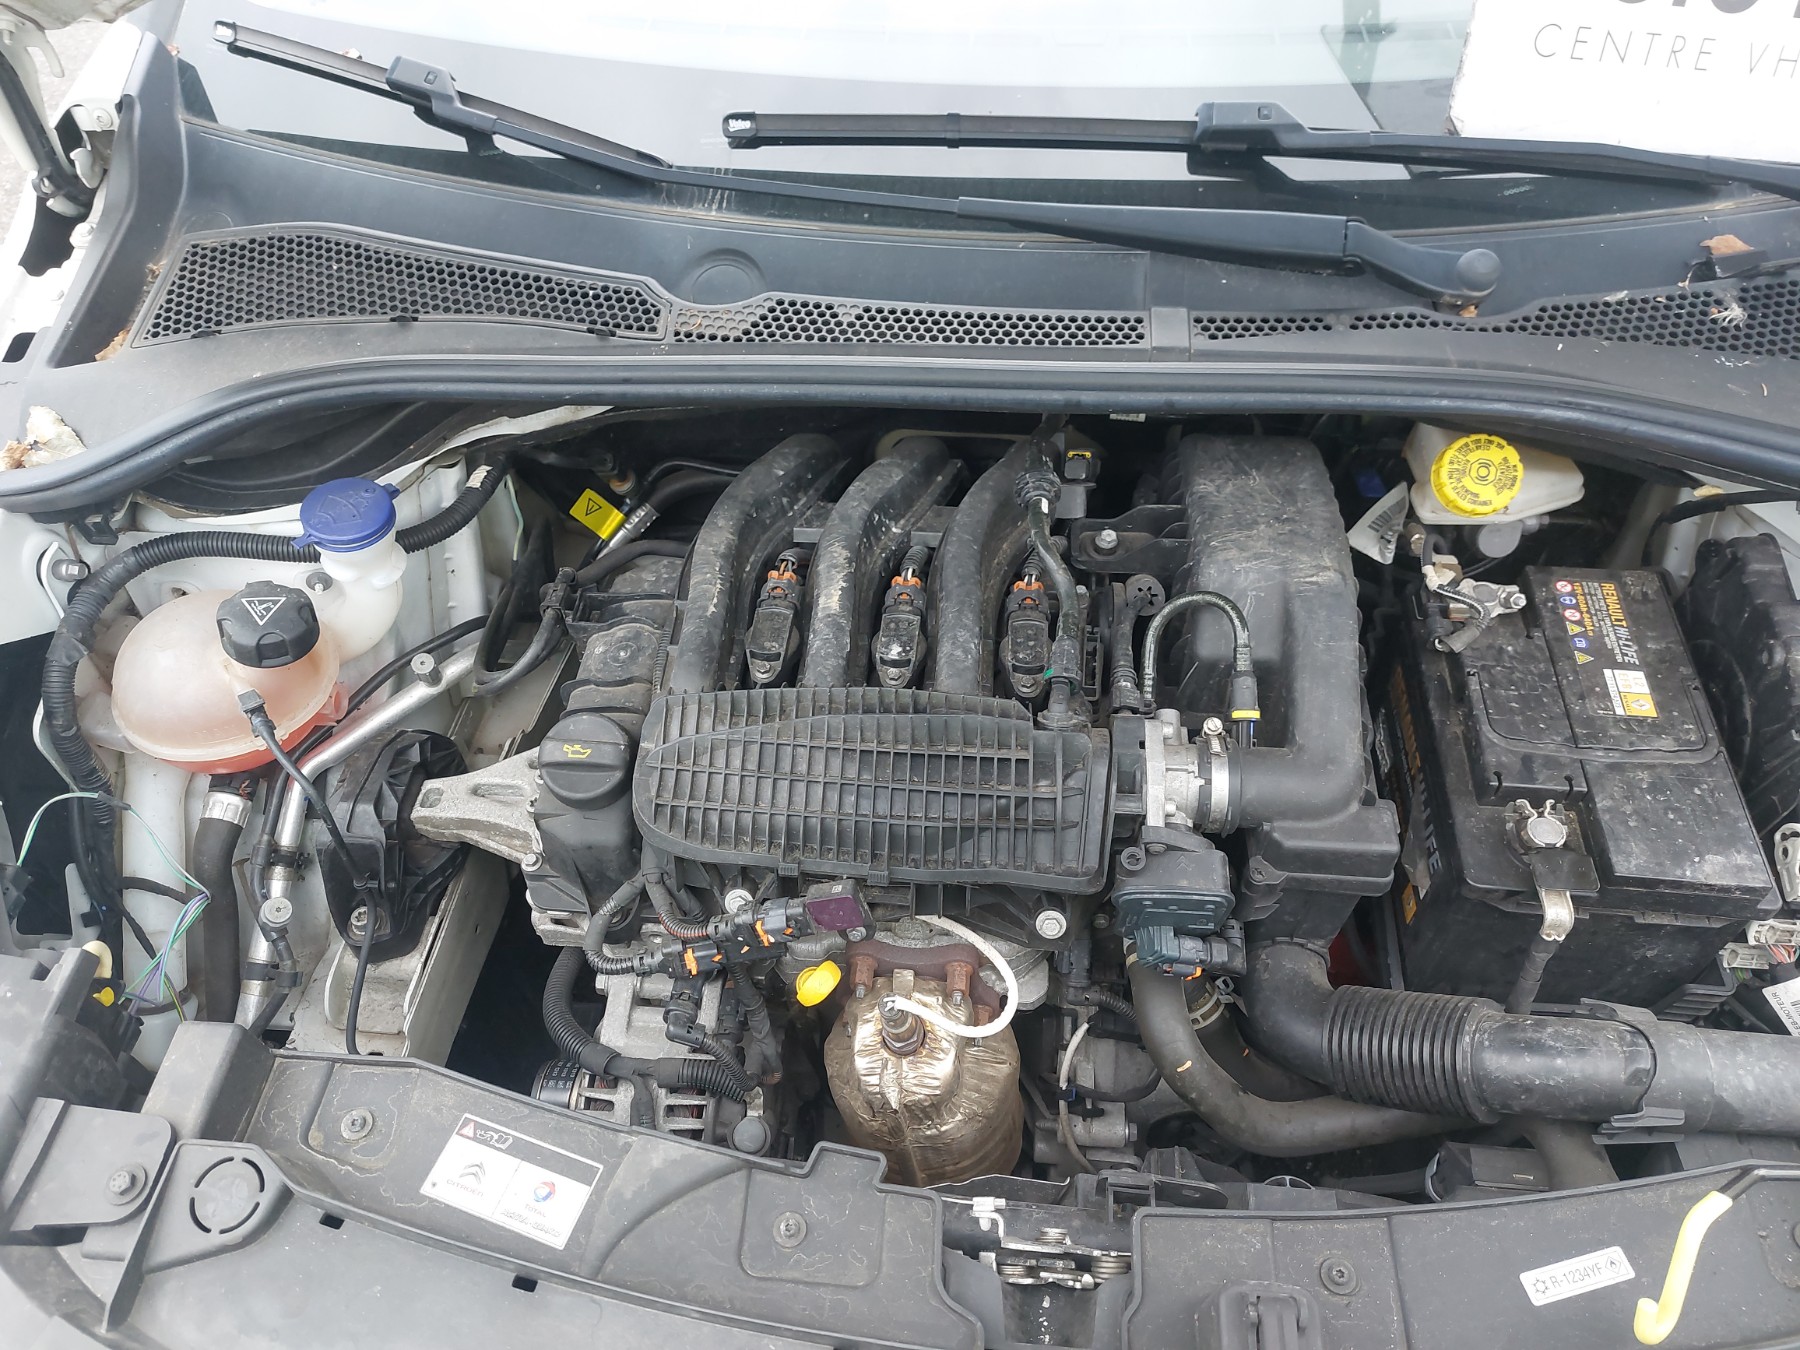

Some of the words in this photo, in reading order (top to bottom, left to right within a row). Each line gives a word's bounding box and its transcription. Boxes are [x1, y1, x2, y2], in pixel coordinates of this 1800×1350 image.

[1534, 23, 1717, 71] CENTRE
[1601, 583, 1627, 627] RENAULT
[524, 1203, 547, 1218] TOTAL
[1549, 1262, 1604, 1289] R-1234YF
